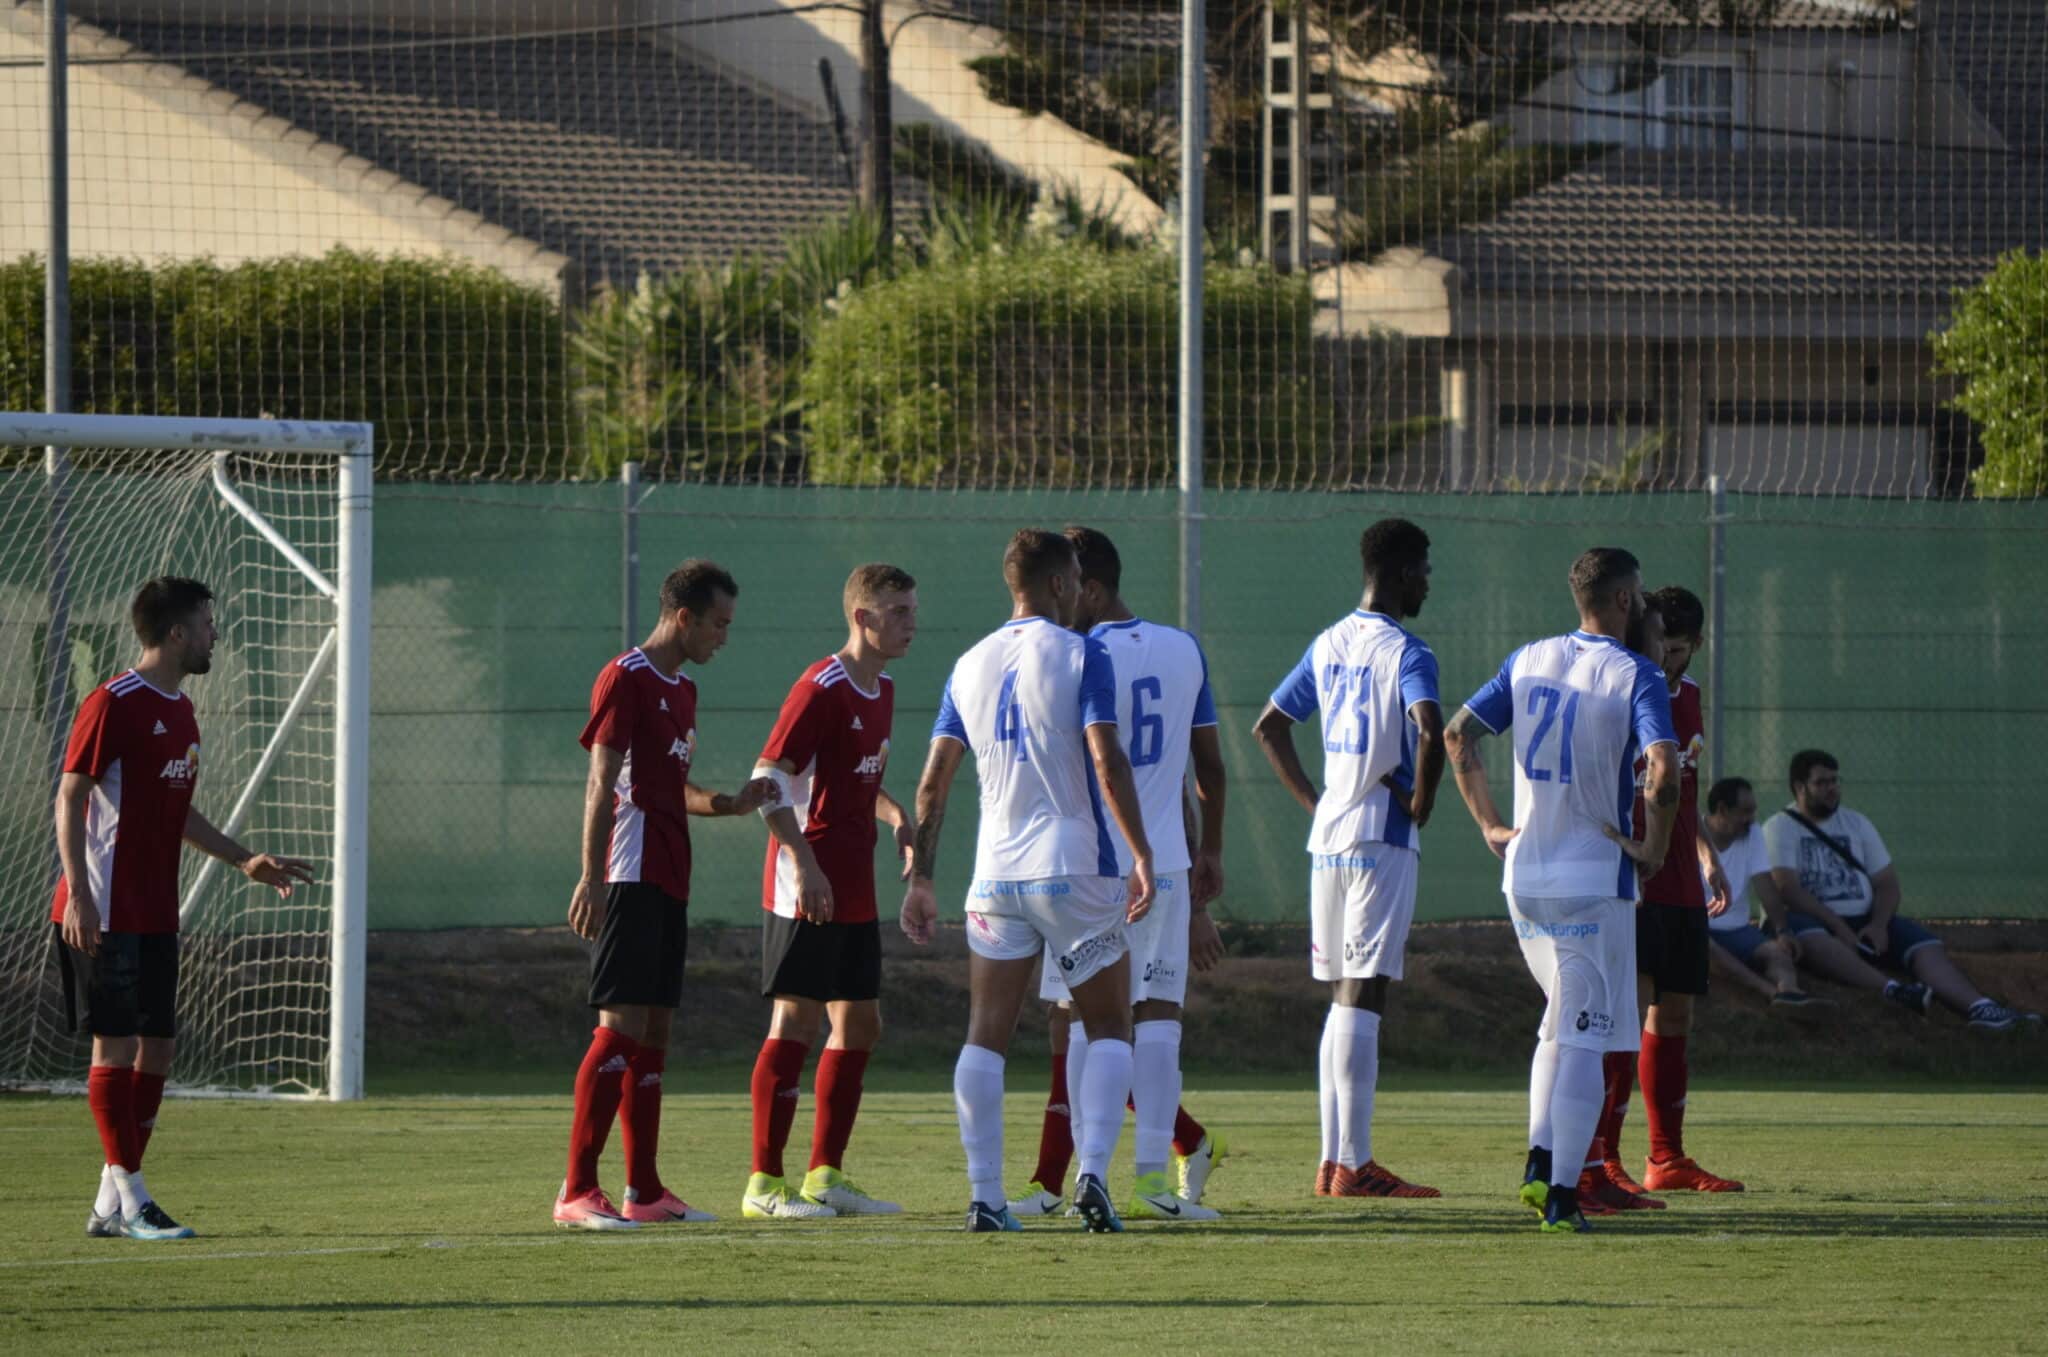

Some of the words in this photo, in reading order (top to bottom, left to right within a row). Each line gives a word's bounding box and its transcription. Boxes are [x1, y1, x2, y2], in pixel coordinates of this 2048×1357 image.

[995, 669, 1031, 762] 4
[1129, 676, 1164, 768] 6
[1322, 664, 1372, 755] 23
[1524, 686, 1580, 785] 21
[159, 759, 186, 778] AFE
